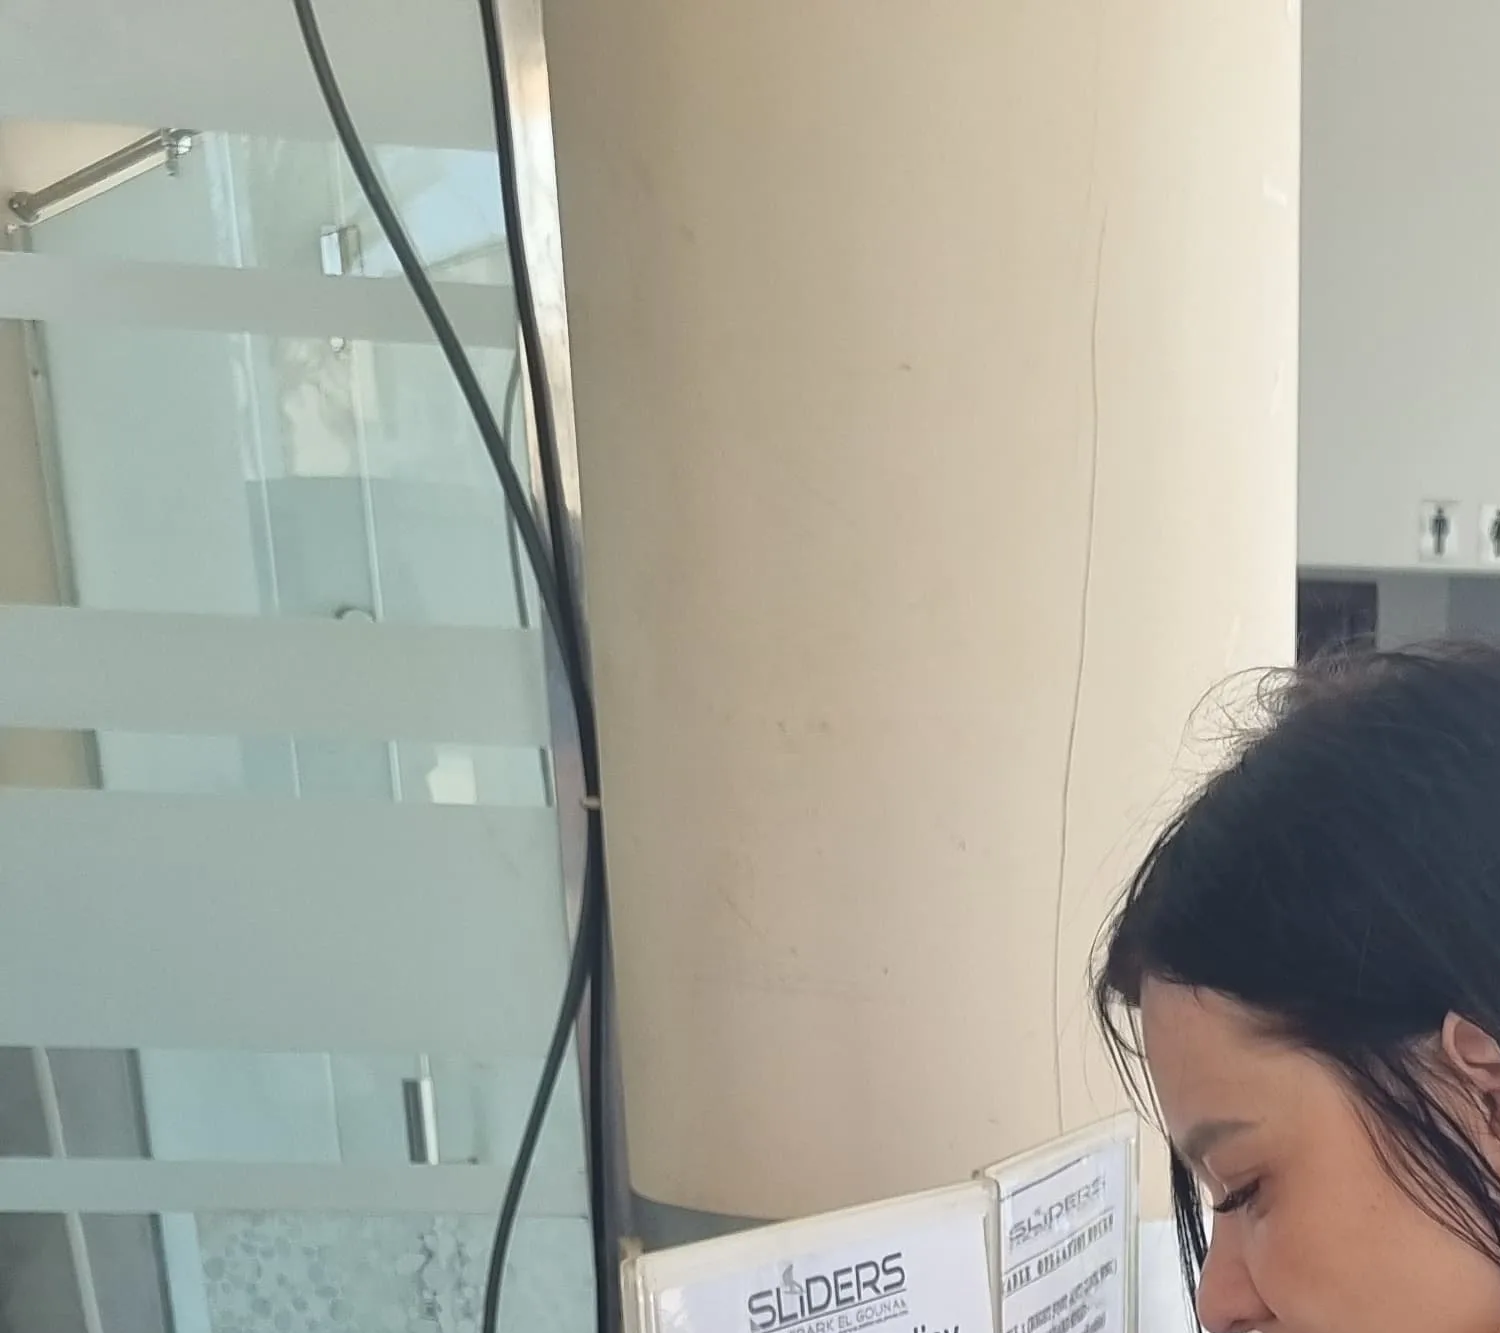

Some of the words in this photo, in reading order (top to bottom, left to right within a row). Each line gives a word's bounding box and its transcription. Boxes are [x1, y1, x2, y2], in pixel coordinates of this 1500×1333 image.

[748, 1252, 905, 1330] SLIDERS
[838, 1314, 852, 1329] EL
[856, 1298, 903, 1322] GOUNA
